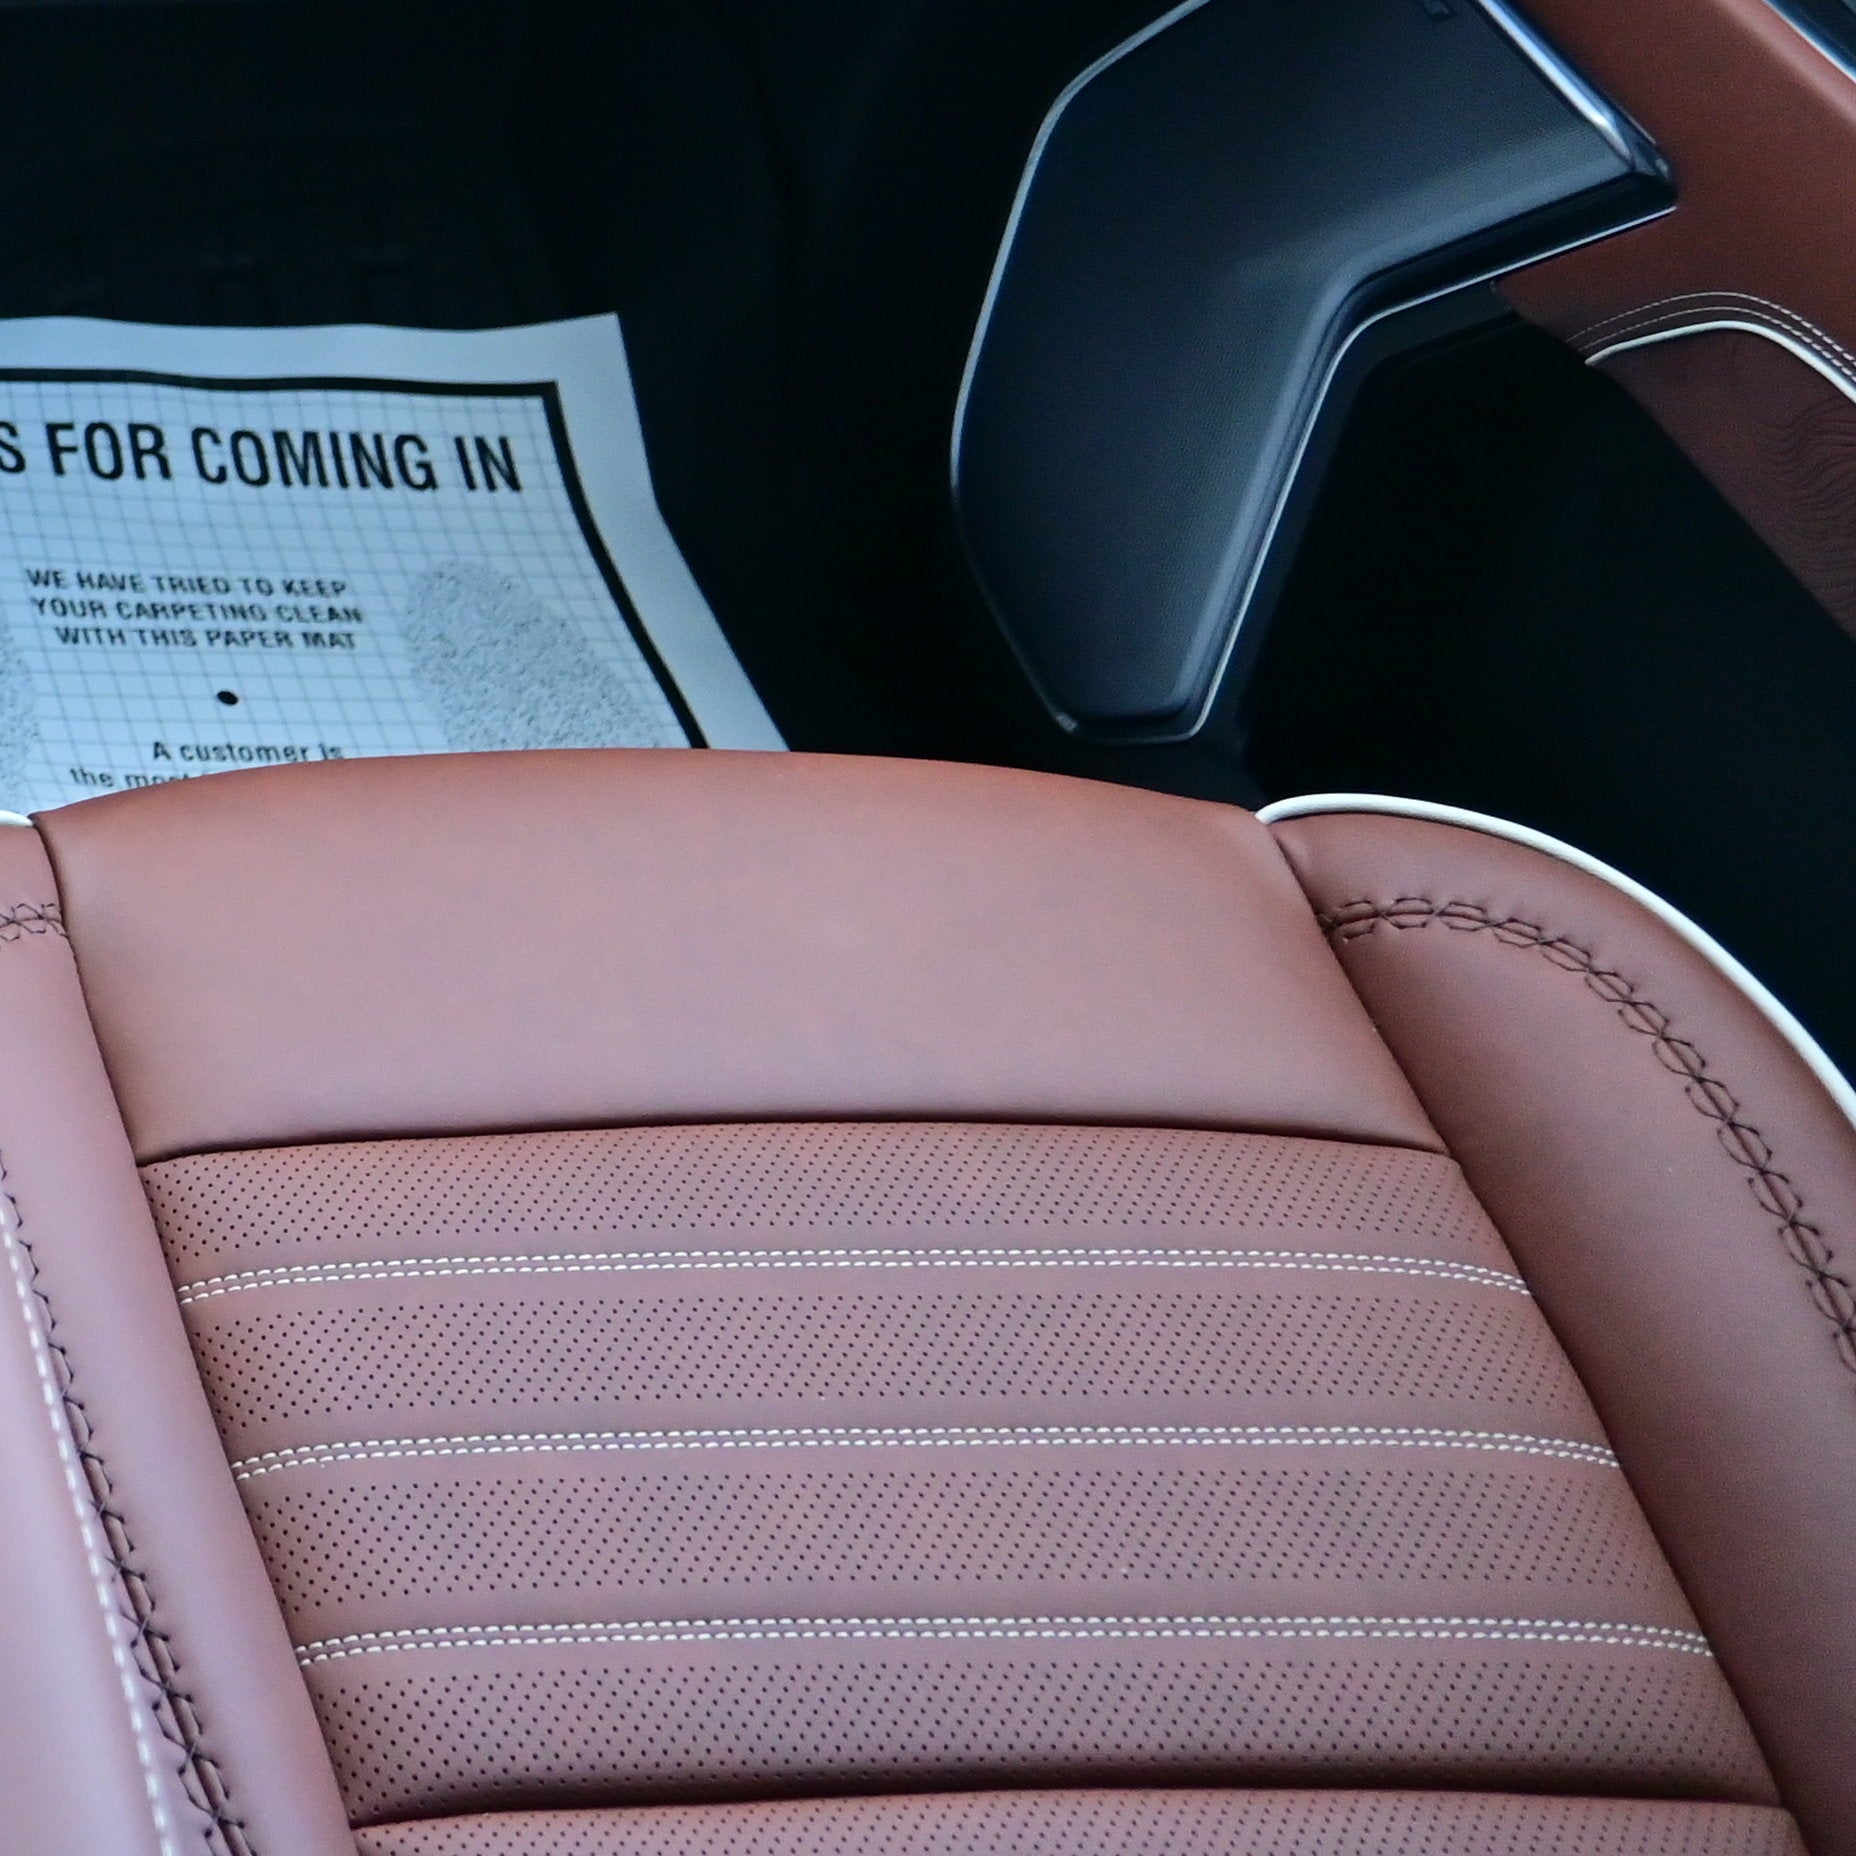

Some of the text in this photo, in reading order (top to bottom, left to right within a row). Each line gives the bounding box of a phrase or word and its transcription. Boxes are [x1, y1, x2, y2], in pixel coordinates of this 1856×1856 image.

[43, 421, 174, 482] FOR
[190, 425, 439, 493] COMING
[452, 433, 525, 495] IN
[25, 567, 348, 599] WE HAVE TRIED TO KEEP
[30, 596, 365, 626] YOUR CARPETING CLEAN
[54, 624, 358, 651] WITH THIS PAPER MAT
[151, 740, 345, 765] A customer is
[69, 767, 115, 789] the
